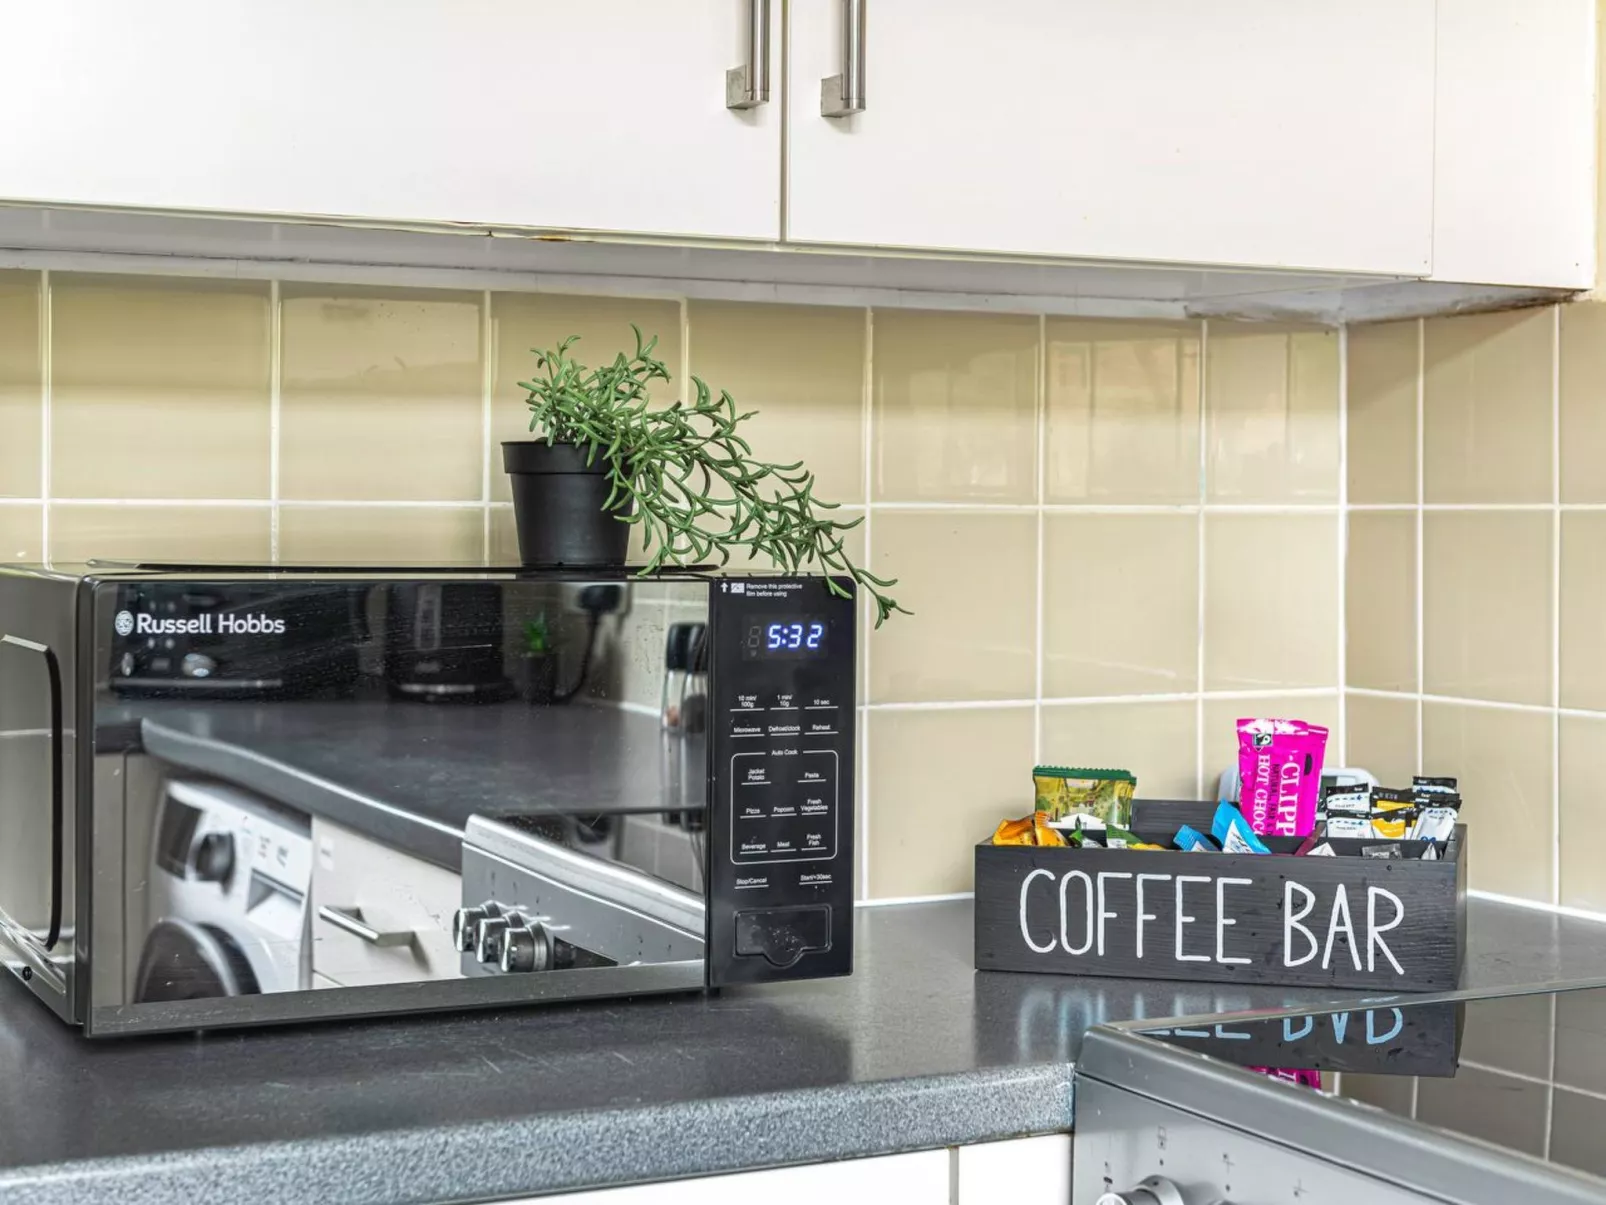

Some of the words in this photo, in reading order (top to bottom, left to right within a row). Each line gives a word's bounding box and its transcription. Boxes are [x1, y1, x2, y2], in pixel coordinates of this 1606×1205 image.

[778, 583, 803, 591] protective
[137, 612, 213, 635] Russell
[218, 613, 286, 635] Hobbs
[767, 624, 824, 649] 5:32
[1257, 754, 1270, 785] HOT
[800, 804, 828, 812] Vegetables
[736, 877, 768, 886] Stop/Cancel
[1018, 867, 1254, 966] COFFEE
[1283, 881, 1405, 976] BAR
